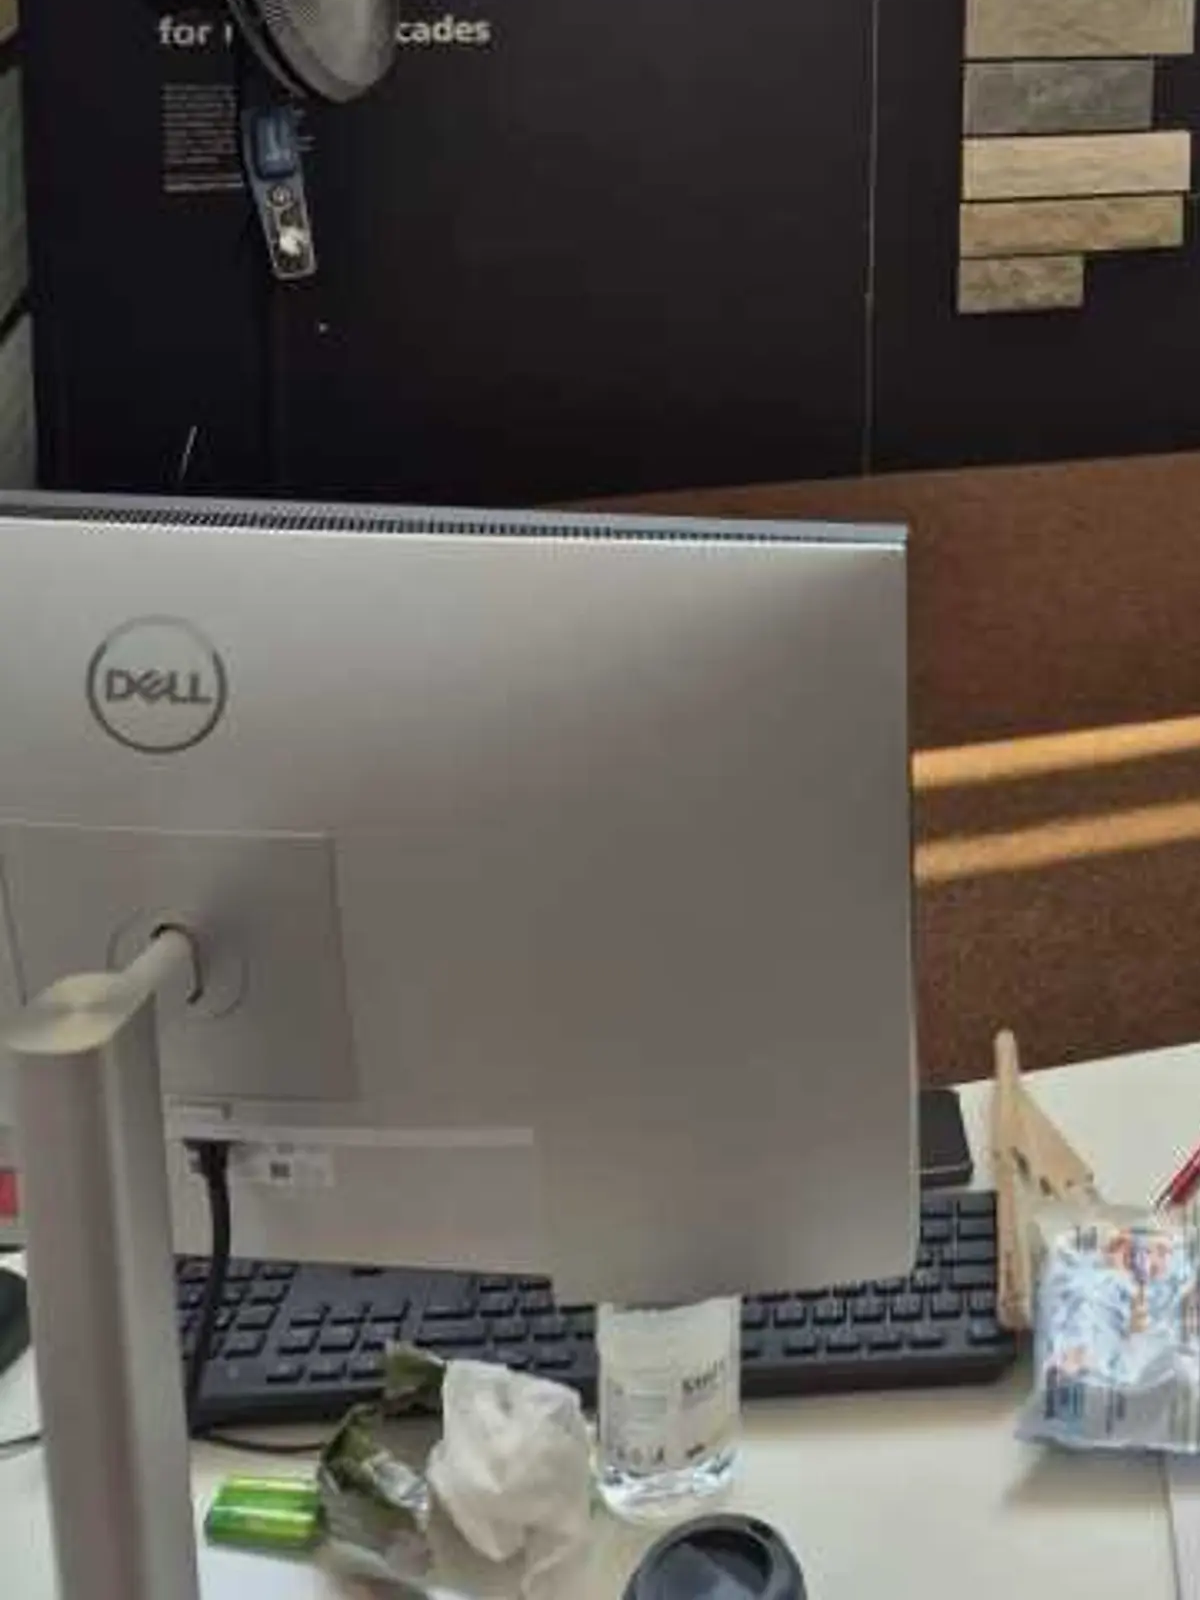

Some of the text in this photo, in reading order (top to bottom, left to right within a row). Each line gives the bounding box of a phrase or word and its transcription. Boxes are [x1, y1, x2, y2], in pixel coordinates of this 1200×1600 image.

[158, 14, 213, 47] for
[394, 14, 493, 45] cades
[106, 668, 213, 705] DELL
